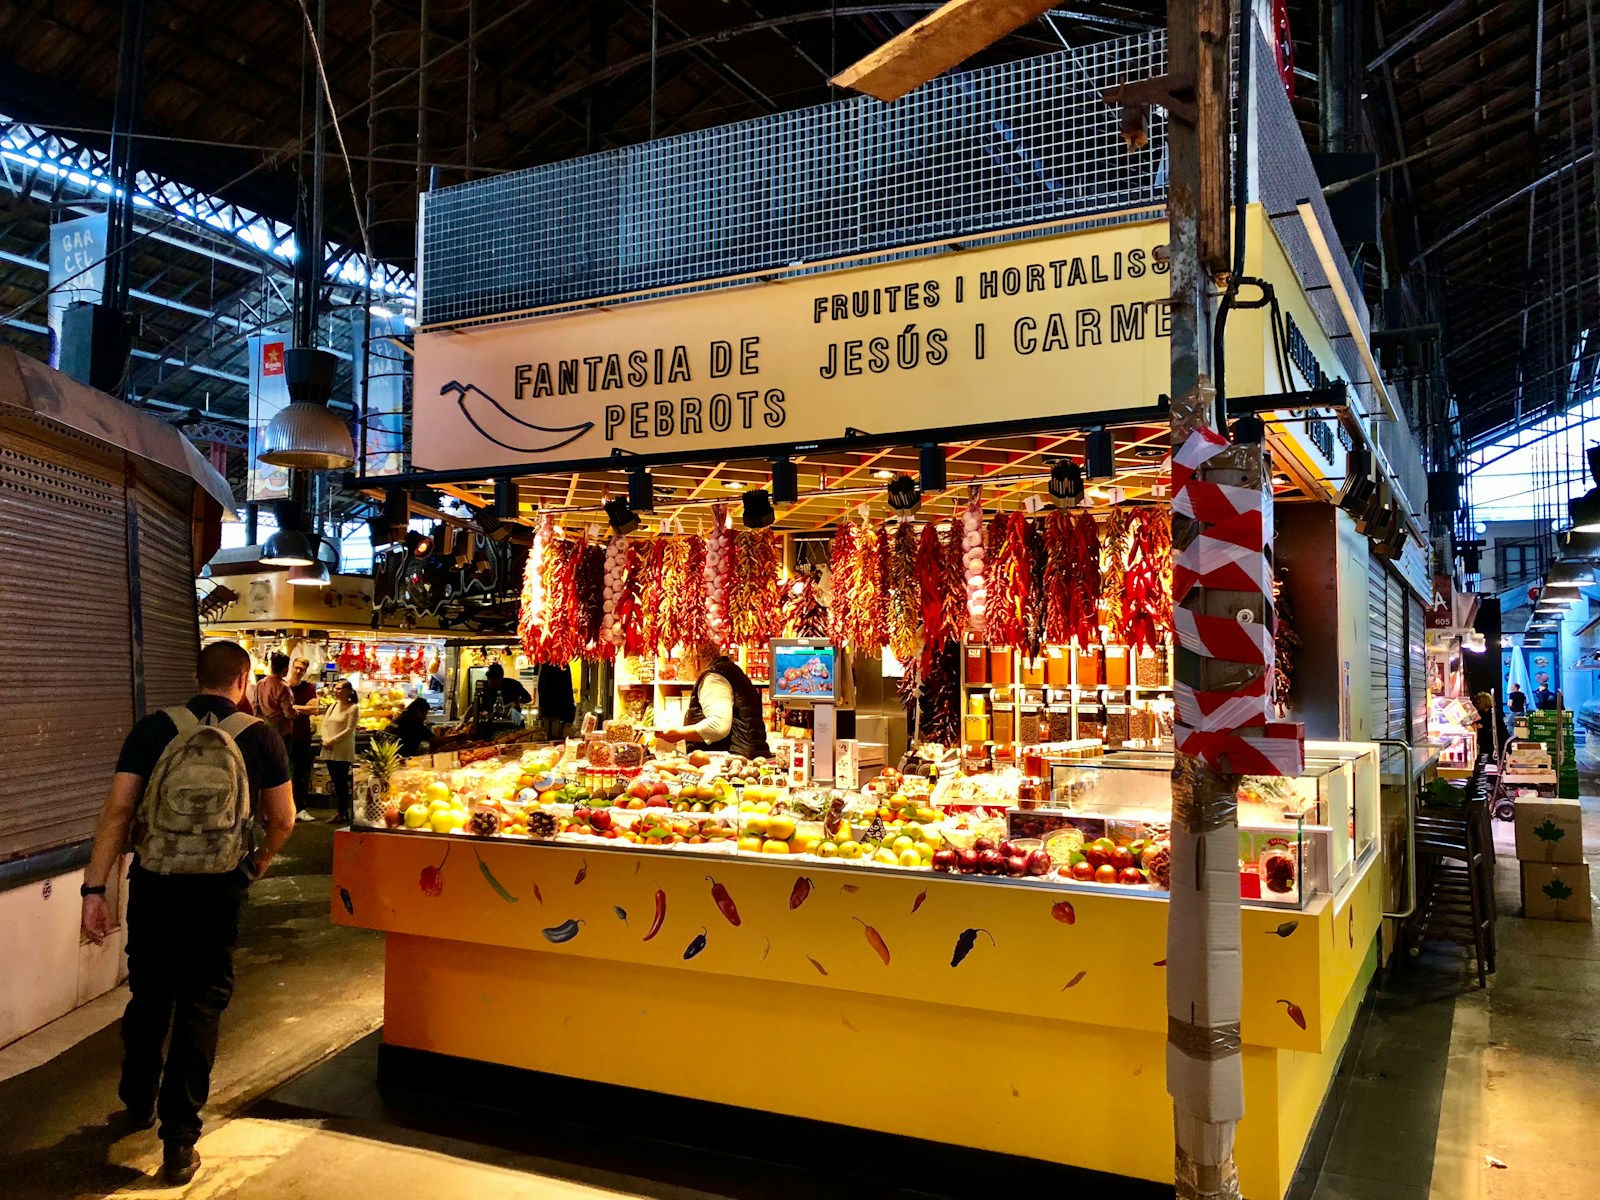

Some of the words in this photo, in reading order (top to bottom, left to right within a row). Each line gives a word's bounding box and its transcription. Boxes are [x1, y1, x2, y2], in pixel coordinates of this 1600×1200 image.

[62, 229, 94, 252] BAR
[813, 280, 940, 323] FRUITES
[955, 275, 964, 303] I
[819, 323, 948, 380] JESÚS
[975, 323, 985, 360] I
[1013, 301, 1171, 355] CARME
[514, 345, 692, 400] FANTASIA
[709, 336, 760, 379] DE
[604, 388, 786, 441] PEBROTS
[1435, 618, 1450, 626] 605
